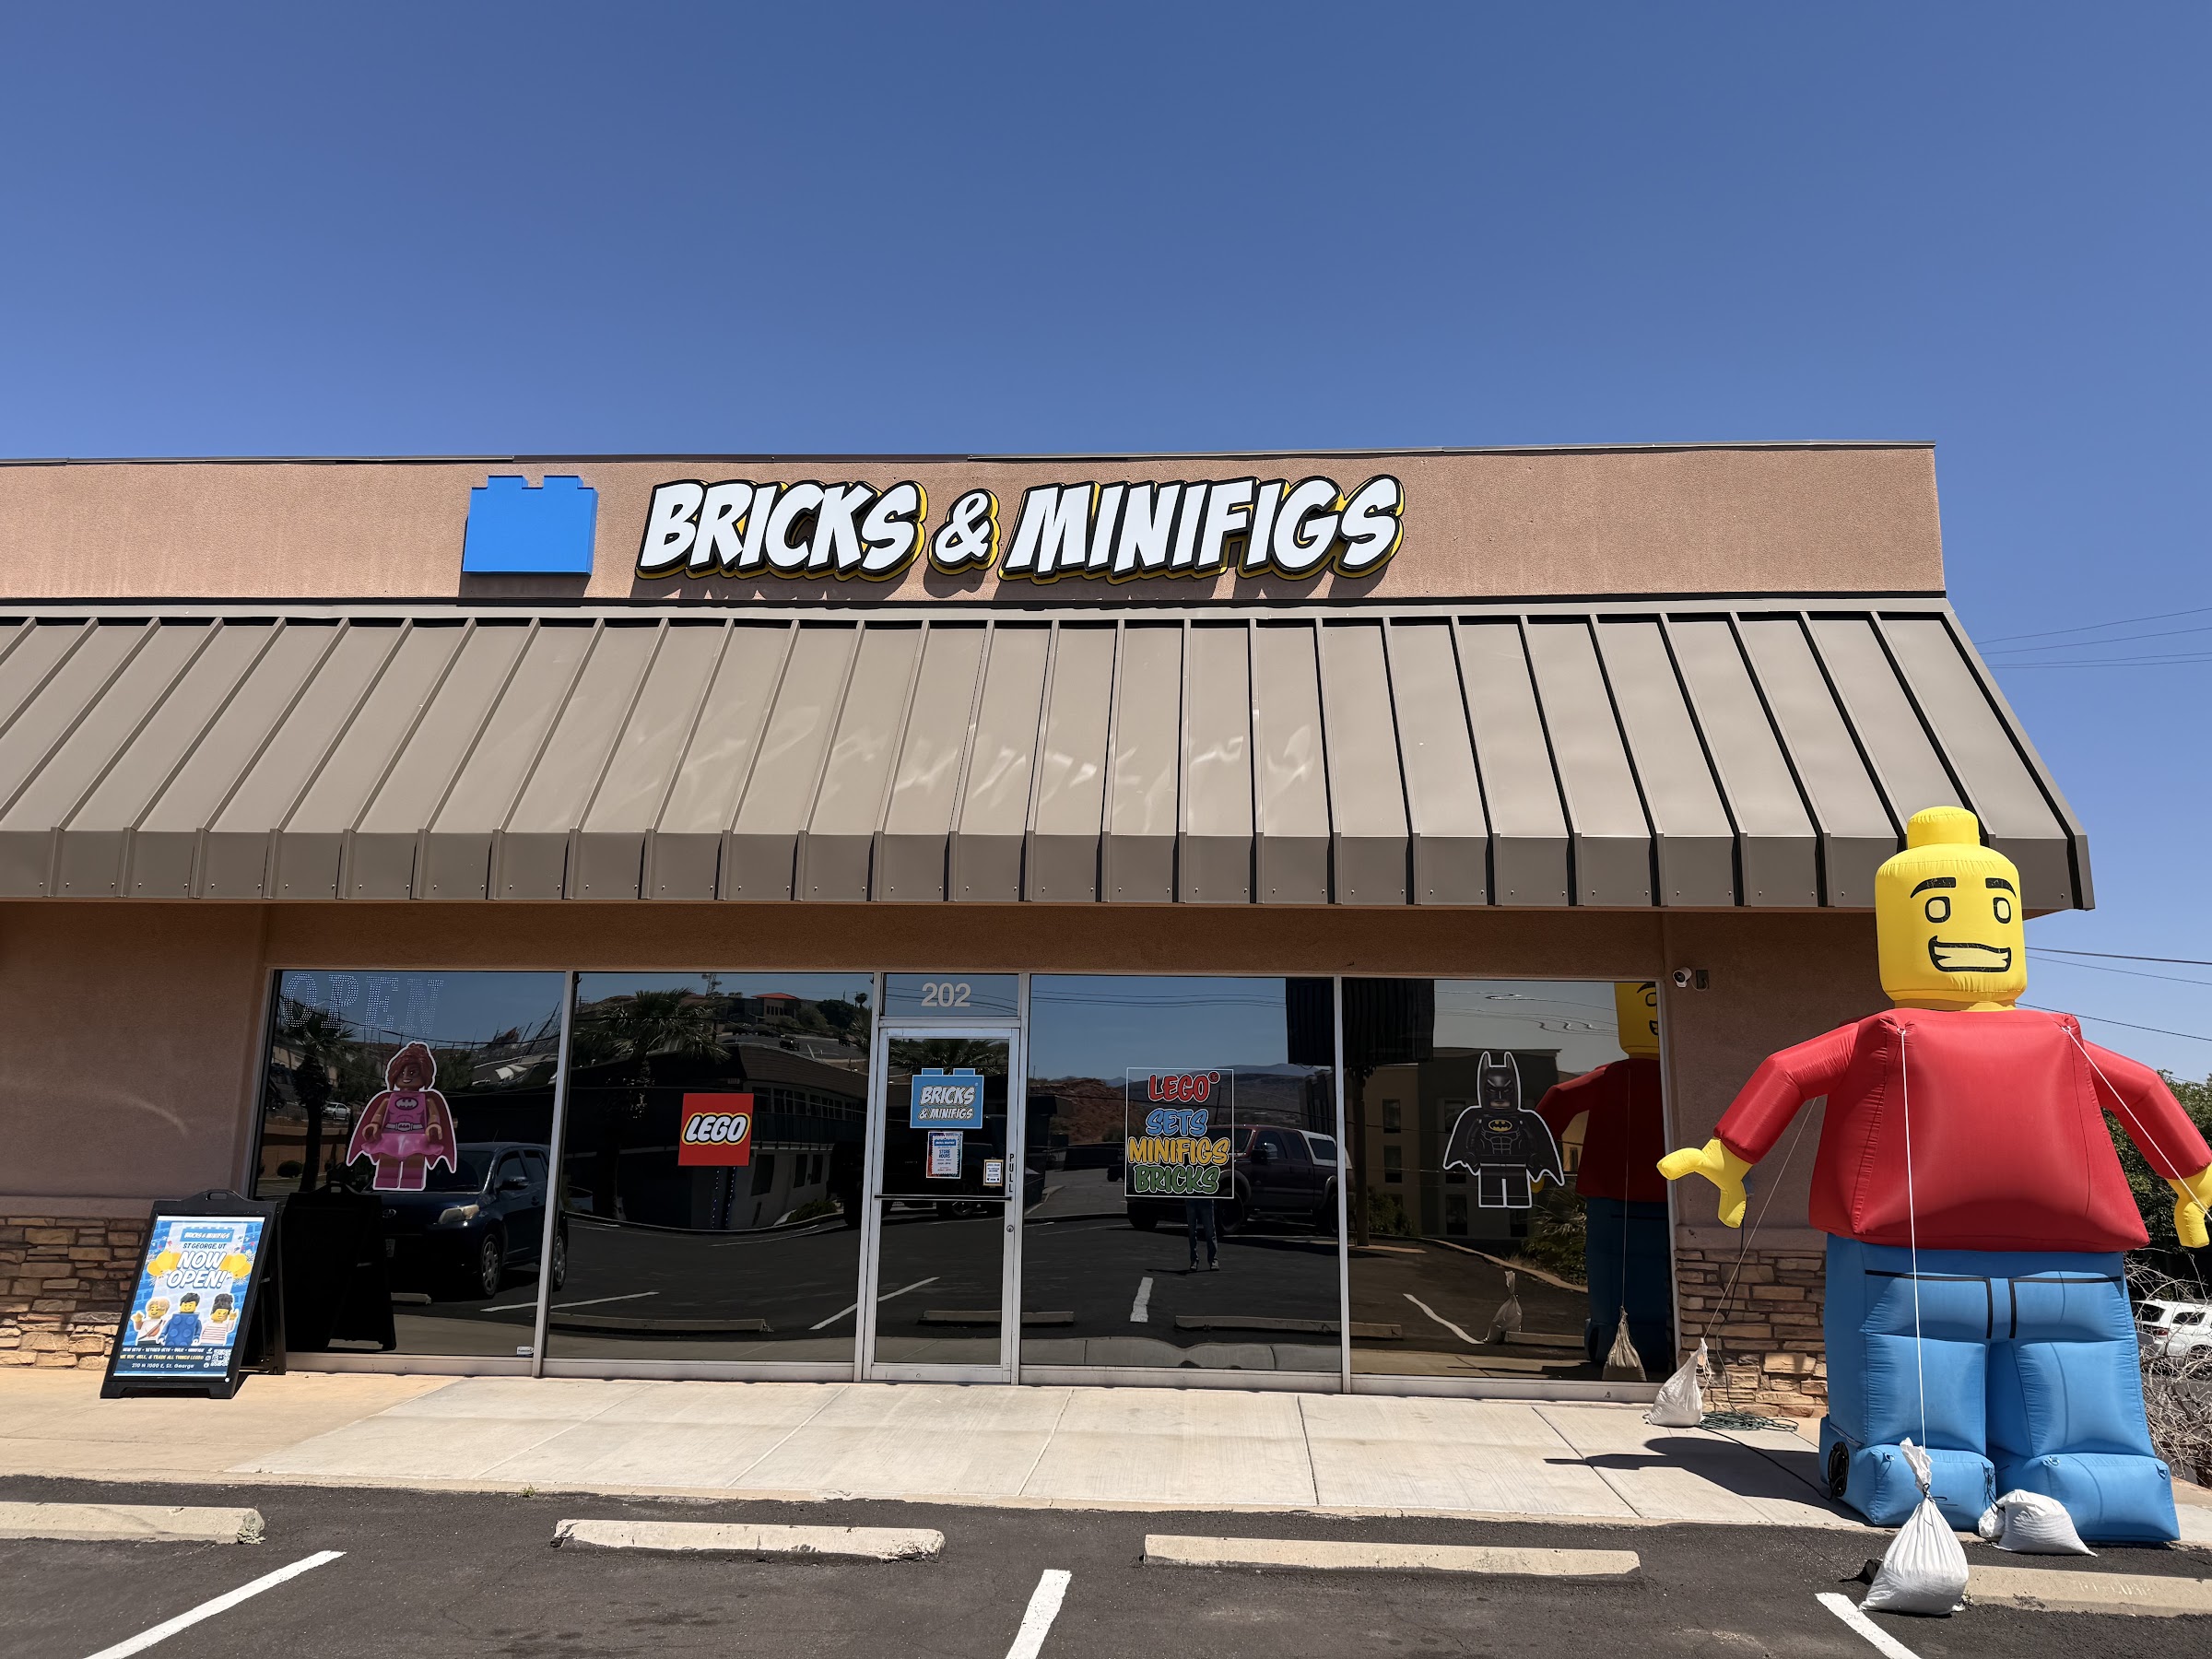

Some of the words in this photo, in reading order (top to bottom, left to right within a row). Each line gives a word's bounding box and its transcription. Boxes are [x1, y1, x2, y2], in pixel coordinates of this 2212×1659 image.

[636, 479, 922, 573] BRICKS
[931, 489, 996, 571] &
[1001, 475, 1402, 577] MINIFIGS
[282, 973, 444, 1034] OPEN
[922, 982, 971, 1007] 202
[920, 1086, 976, 1105] BRICKS
[918, 1107, 928, 1120] &
[929, 1107, 974, 1120] MINIFIGS
[1146, 1108, 1208, 1136] SETS
[683, 1113, 749, 1144] LEGO
[1127, 1136, 1230, 1166] MINIFIGS
[1134, 1165, 1220, 1194] BRICKS
[176, 1251, 228, 1270] NOW
[167, 1270, 228, 1289] OPEN!
